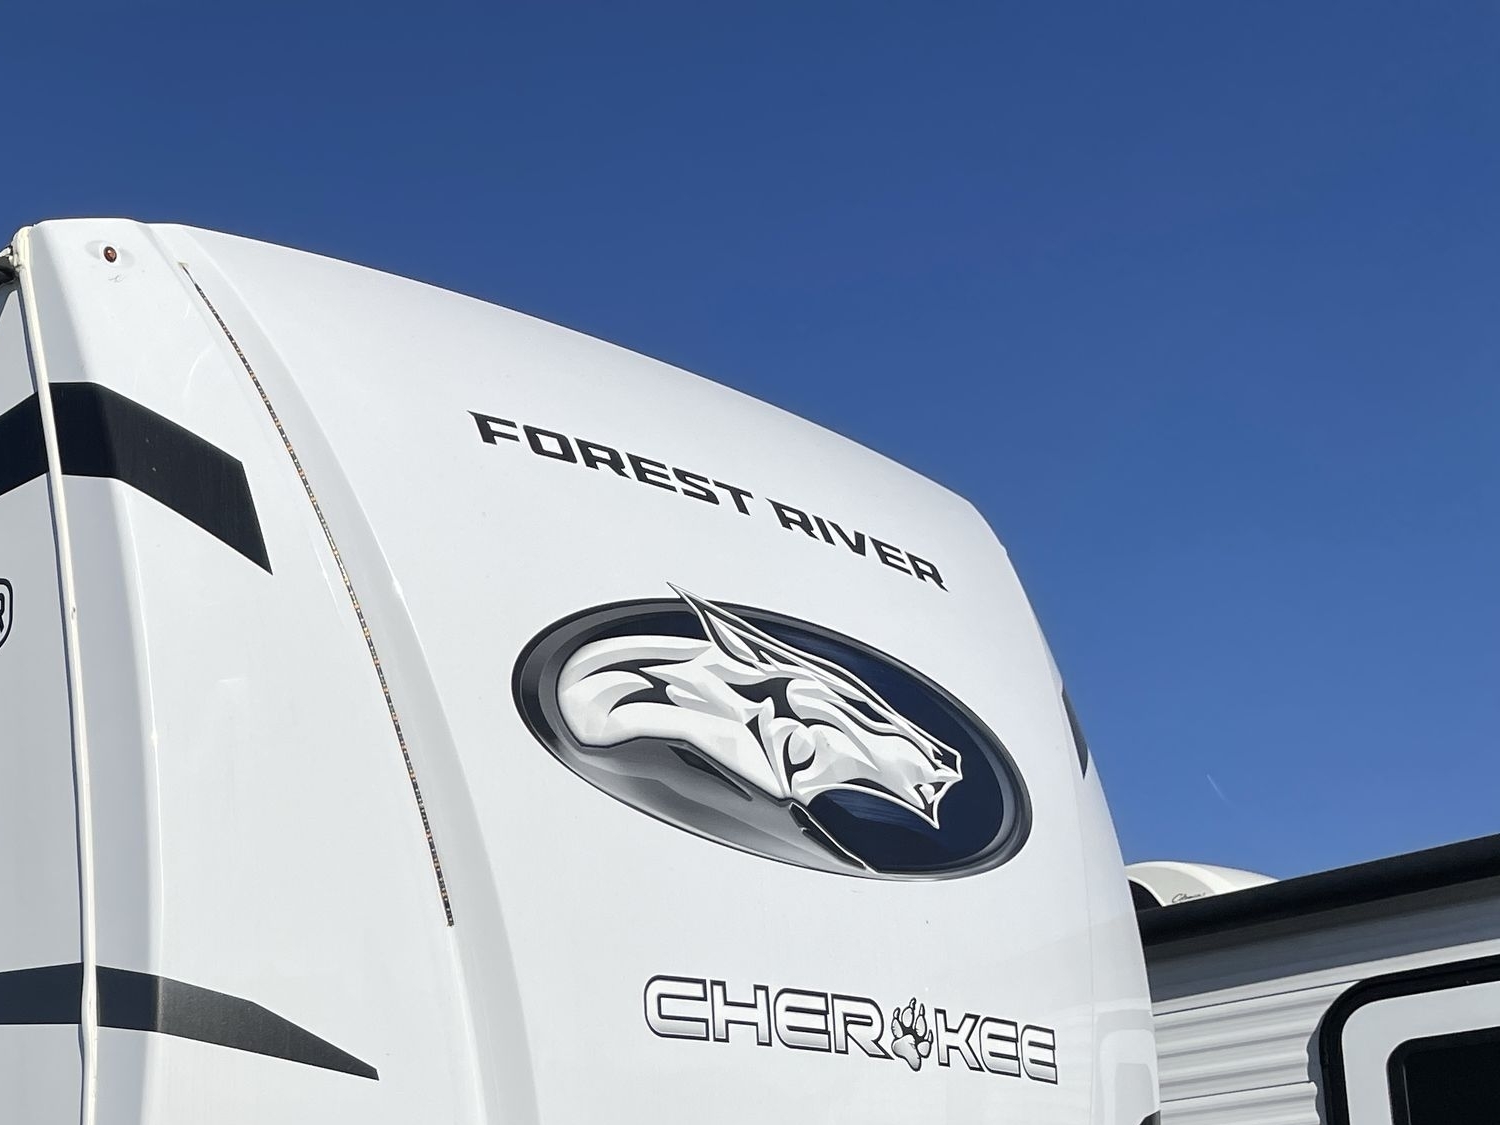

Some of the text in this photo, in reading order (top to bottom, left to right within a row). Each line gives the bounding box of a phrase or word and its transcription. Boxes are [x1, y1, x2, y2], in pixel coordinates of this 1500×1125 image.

[467, 410, 948, 592] FOREST RIVER
[643, 973, 1059, 1085] CHEROKEE
